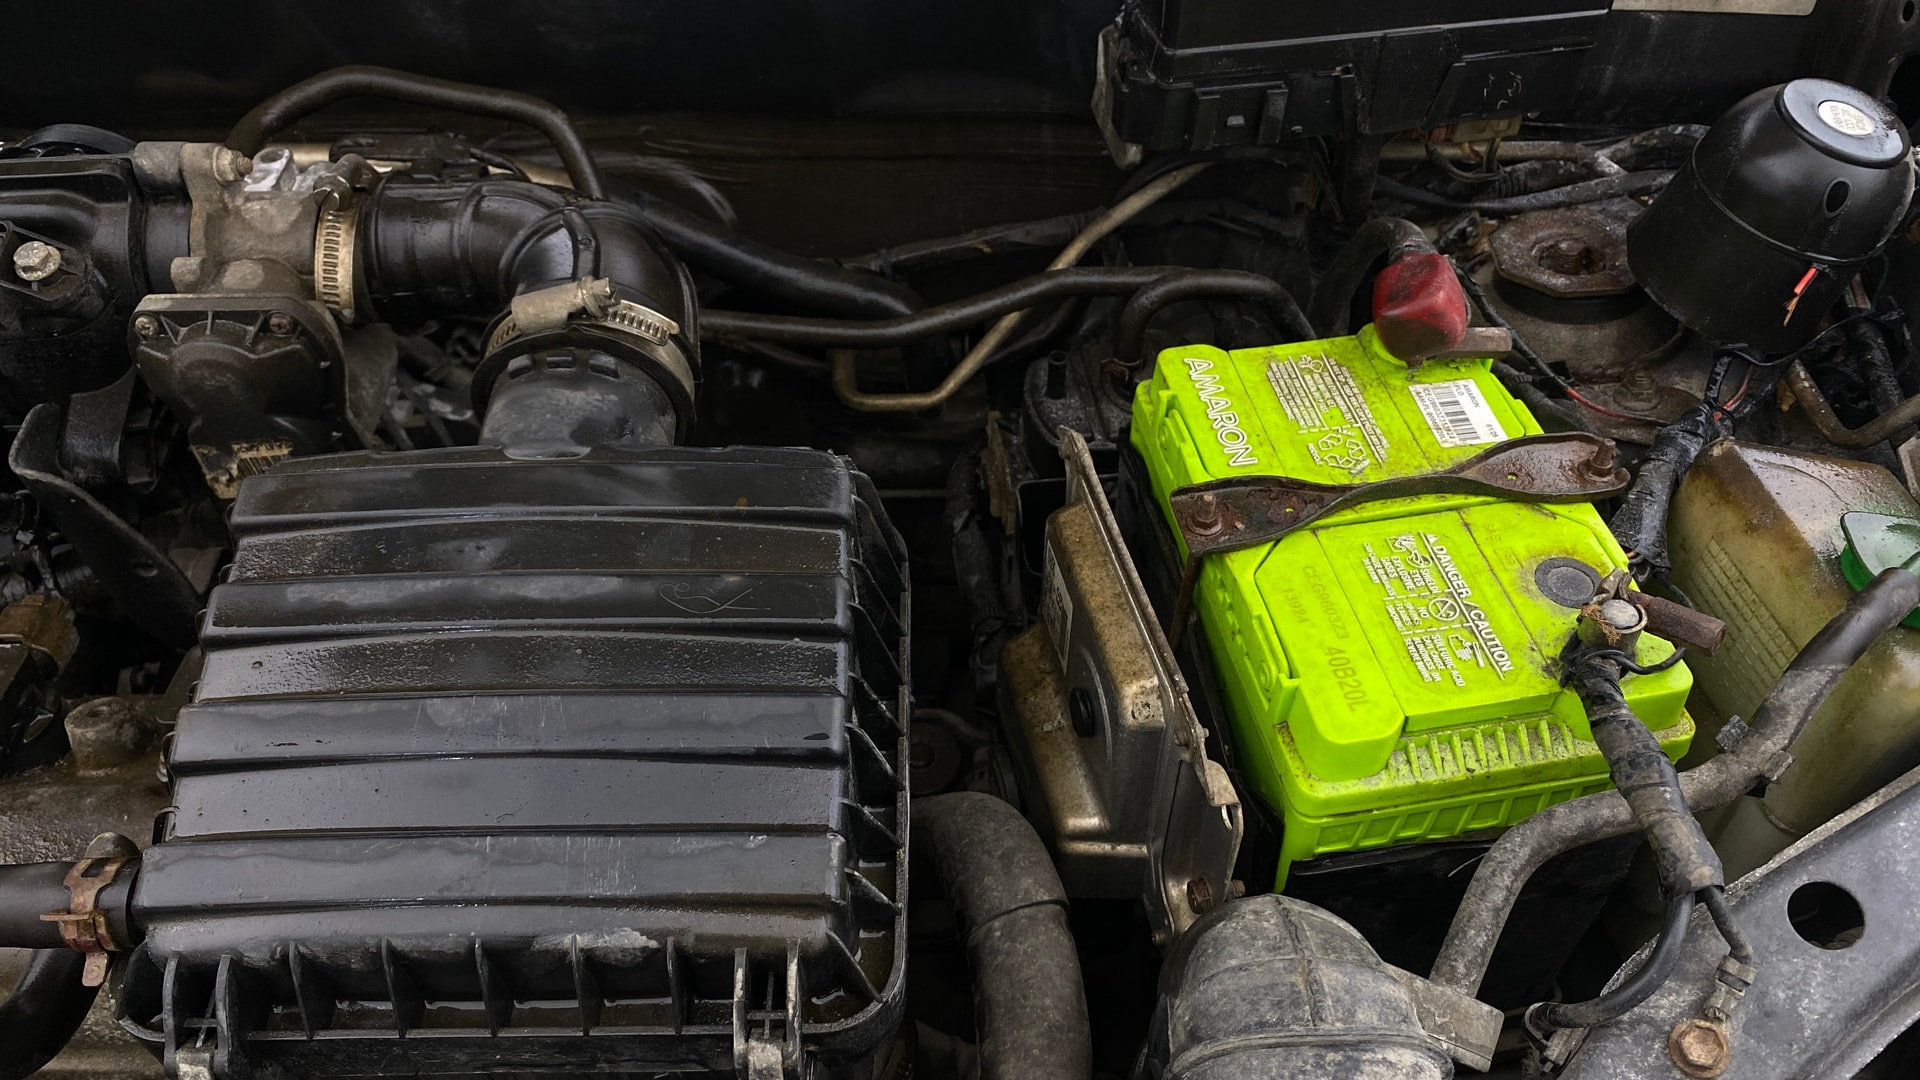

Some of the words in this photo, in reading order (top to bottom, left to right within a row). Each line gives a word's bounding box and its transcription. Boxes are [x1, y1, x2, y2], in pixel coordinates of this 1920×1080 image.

[1452, 384, 1465, 396] FLO
[1461, 384, 1481, 407] AMARON
[1183, 357, 1257, 467] AMARON
[1379, 556, 1398, 577] GASES
[1389, 555, 1416, 590] EXPLOSIVE
[1408, 569, 1425, 586] EYES
[1419, 567, 1439, 591] SHIELD
[1394, 603, 1412, 625] FLAMES
[1403, 602, 1421, 625] SPARKS
[1416, 606, 1429, 617] NO
[1432, 544, 1472, 598] DANGER
[1468, 608, 1515, 671] CAUTION
[1402, 637, 1421, 661] SEVERE
[1415, 661, 1432, 681] BURNS
[1411, 637, 1435, 669] BLINDNESS
[1421, 635, 1434, 648] CAN
[1429, 650, 1445, 670] CAUSE
[1430, 634, 1456, 668] SULFURIC
[1450, 669, 1466, 686] ACID
[1323, 647, 1371, 711] 40B20L
